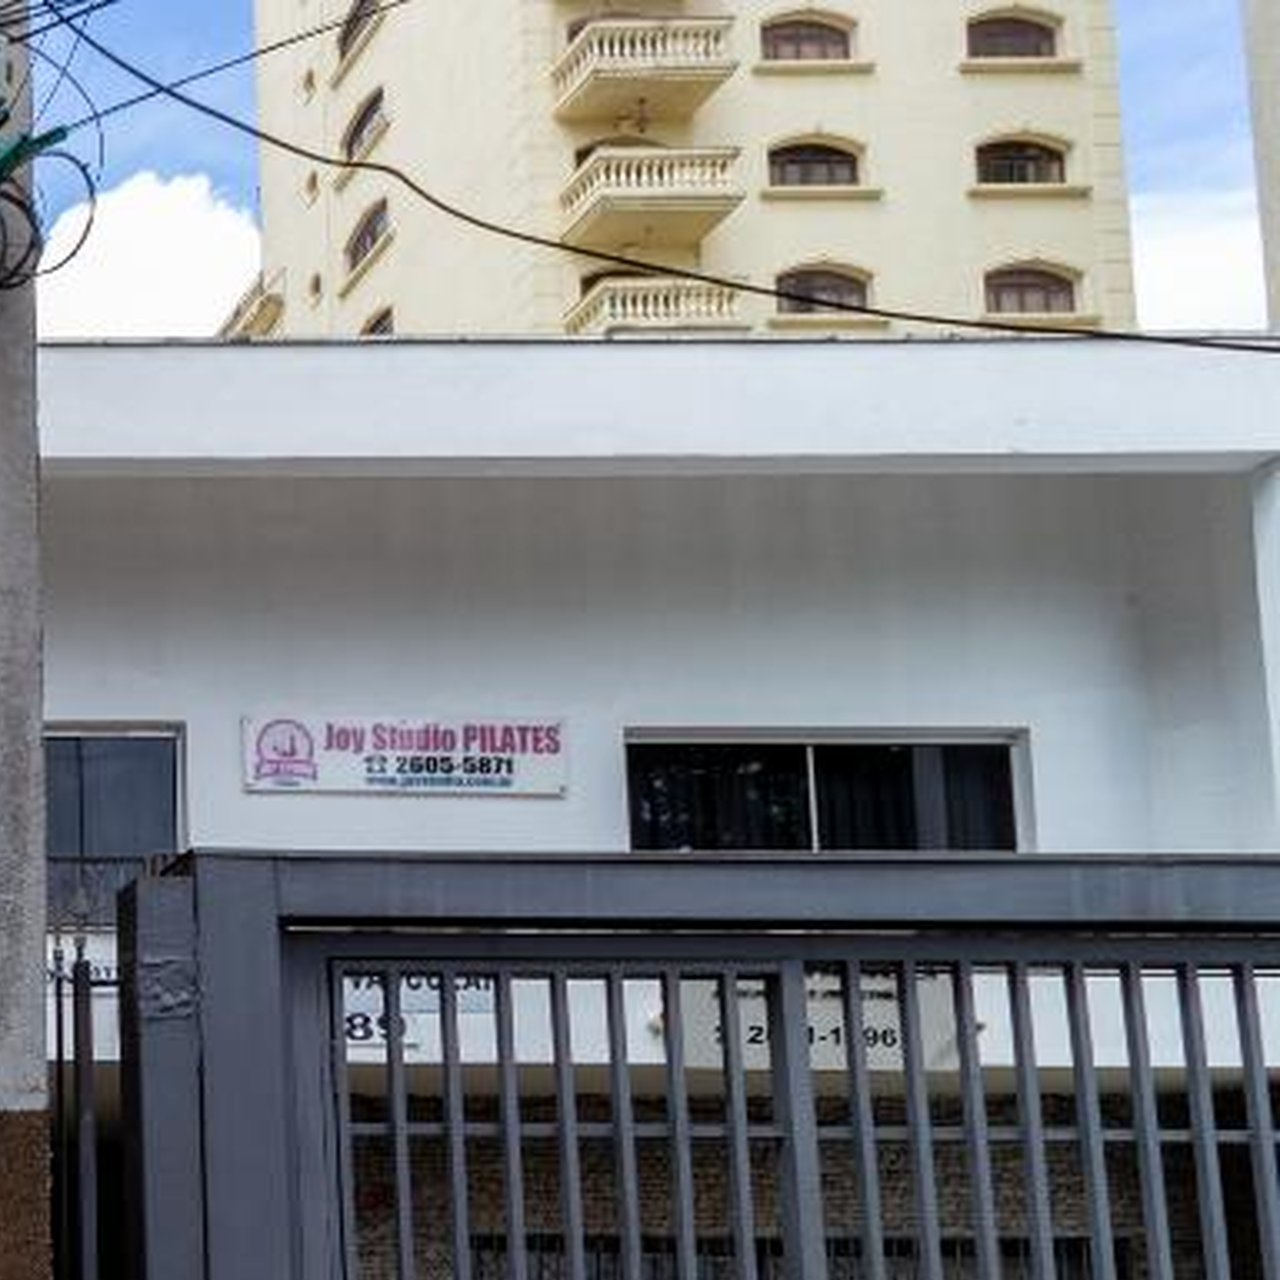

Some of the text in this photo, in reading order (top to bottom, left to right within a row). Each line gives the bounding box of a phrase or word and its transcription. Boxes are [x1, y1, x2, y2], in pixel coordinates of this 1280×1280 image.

[324, 723, 561, 755] Joy Studio PILATES
[396, 755, 513, 774] 2605-5871
